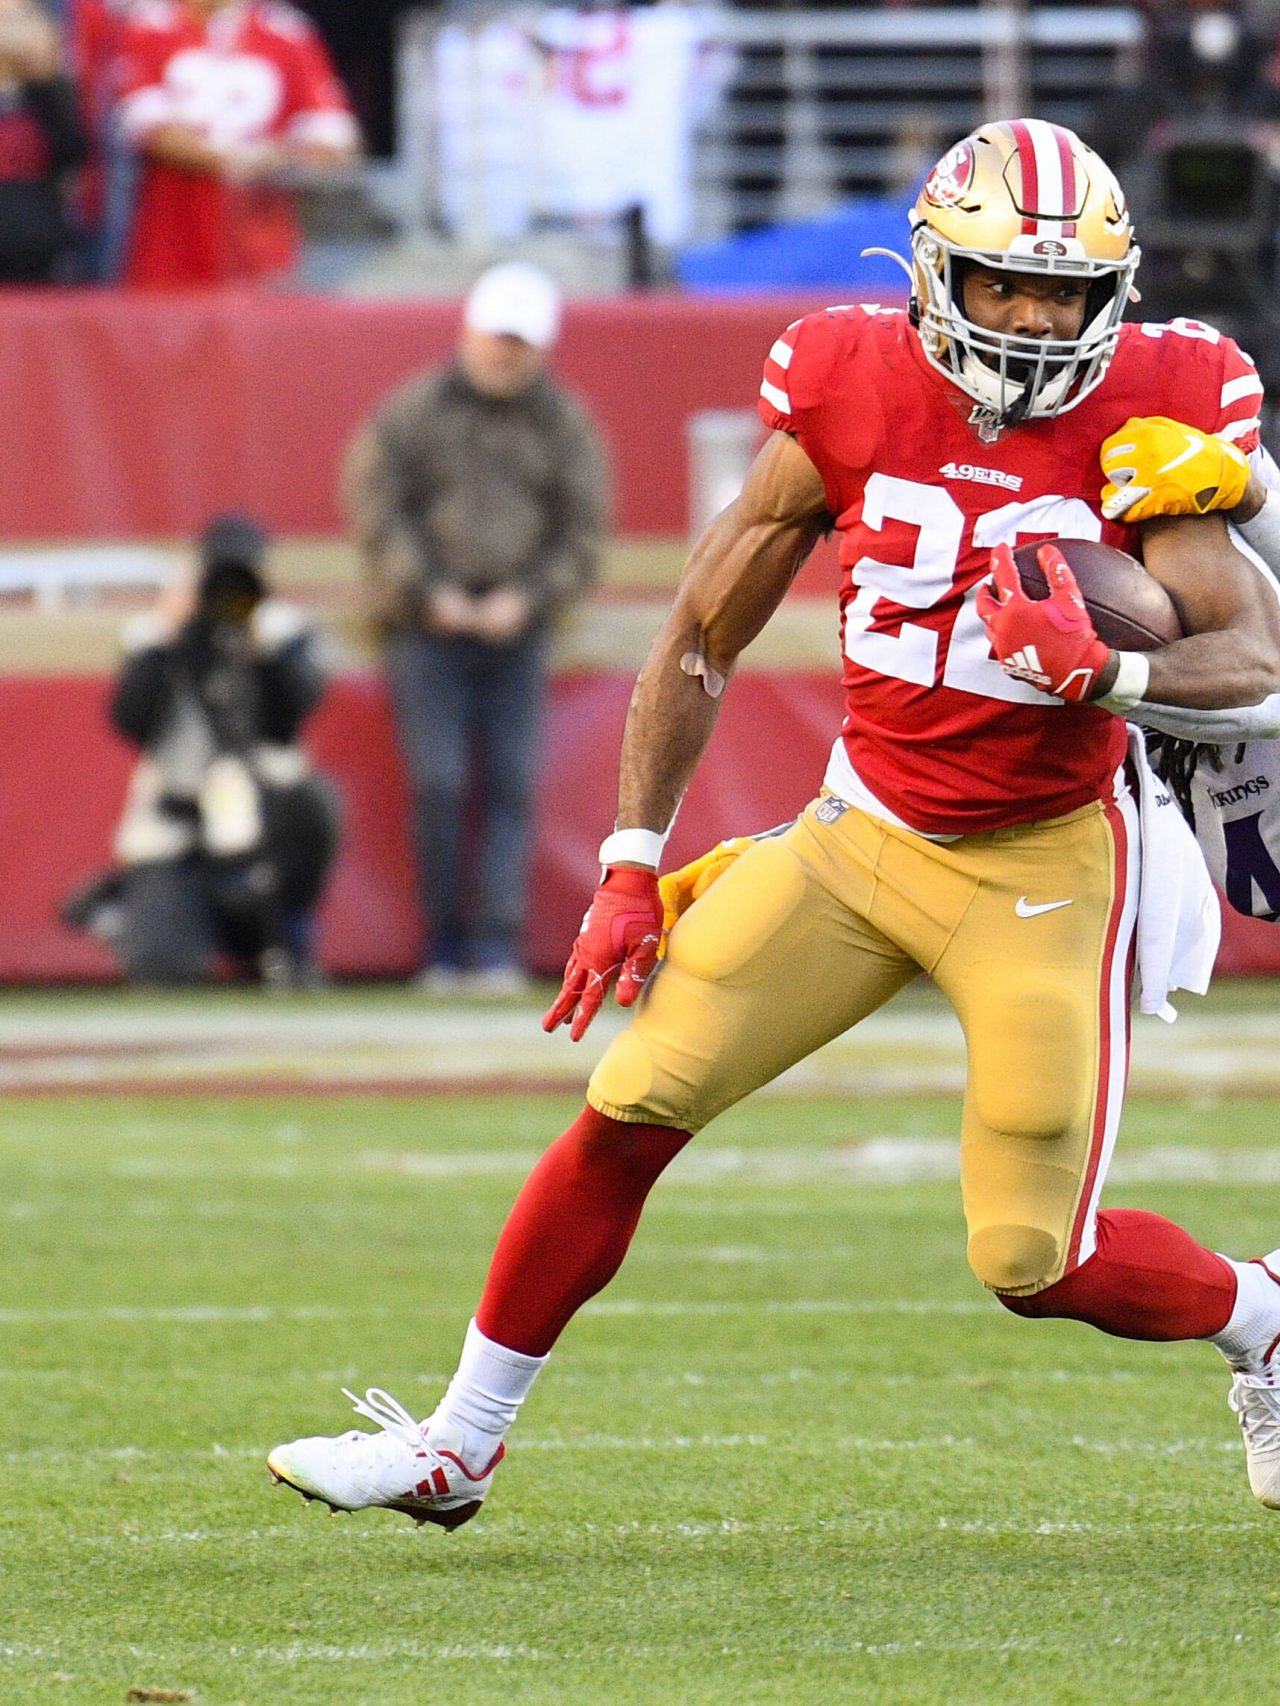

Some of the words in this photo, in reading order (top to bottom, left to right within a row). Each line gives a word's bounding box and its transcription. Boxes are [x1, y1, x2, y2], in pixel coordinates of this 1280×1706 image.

[938, 462, 1024, 492] 49ERS
[845, 472, 1102, 706] 22
[1000, 664, 1052, 686] adidas
[1206, 775, 1270, 810] KINGS
